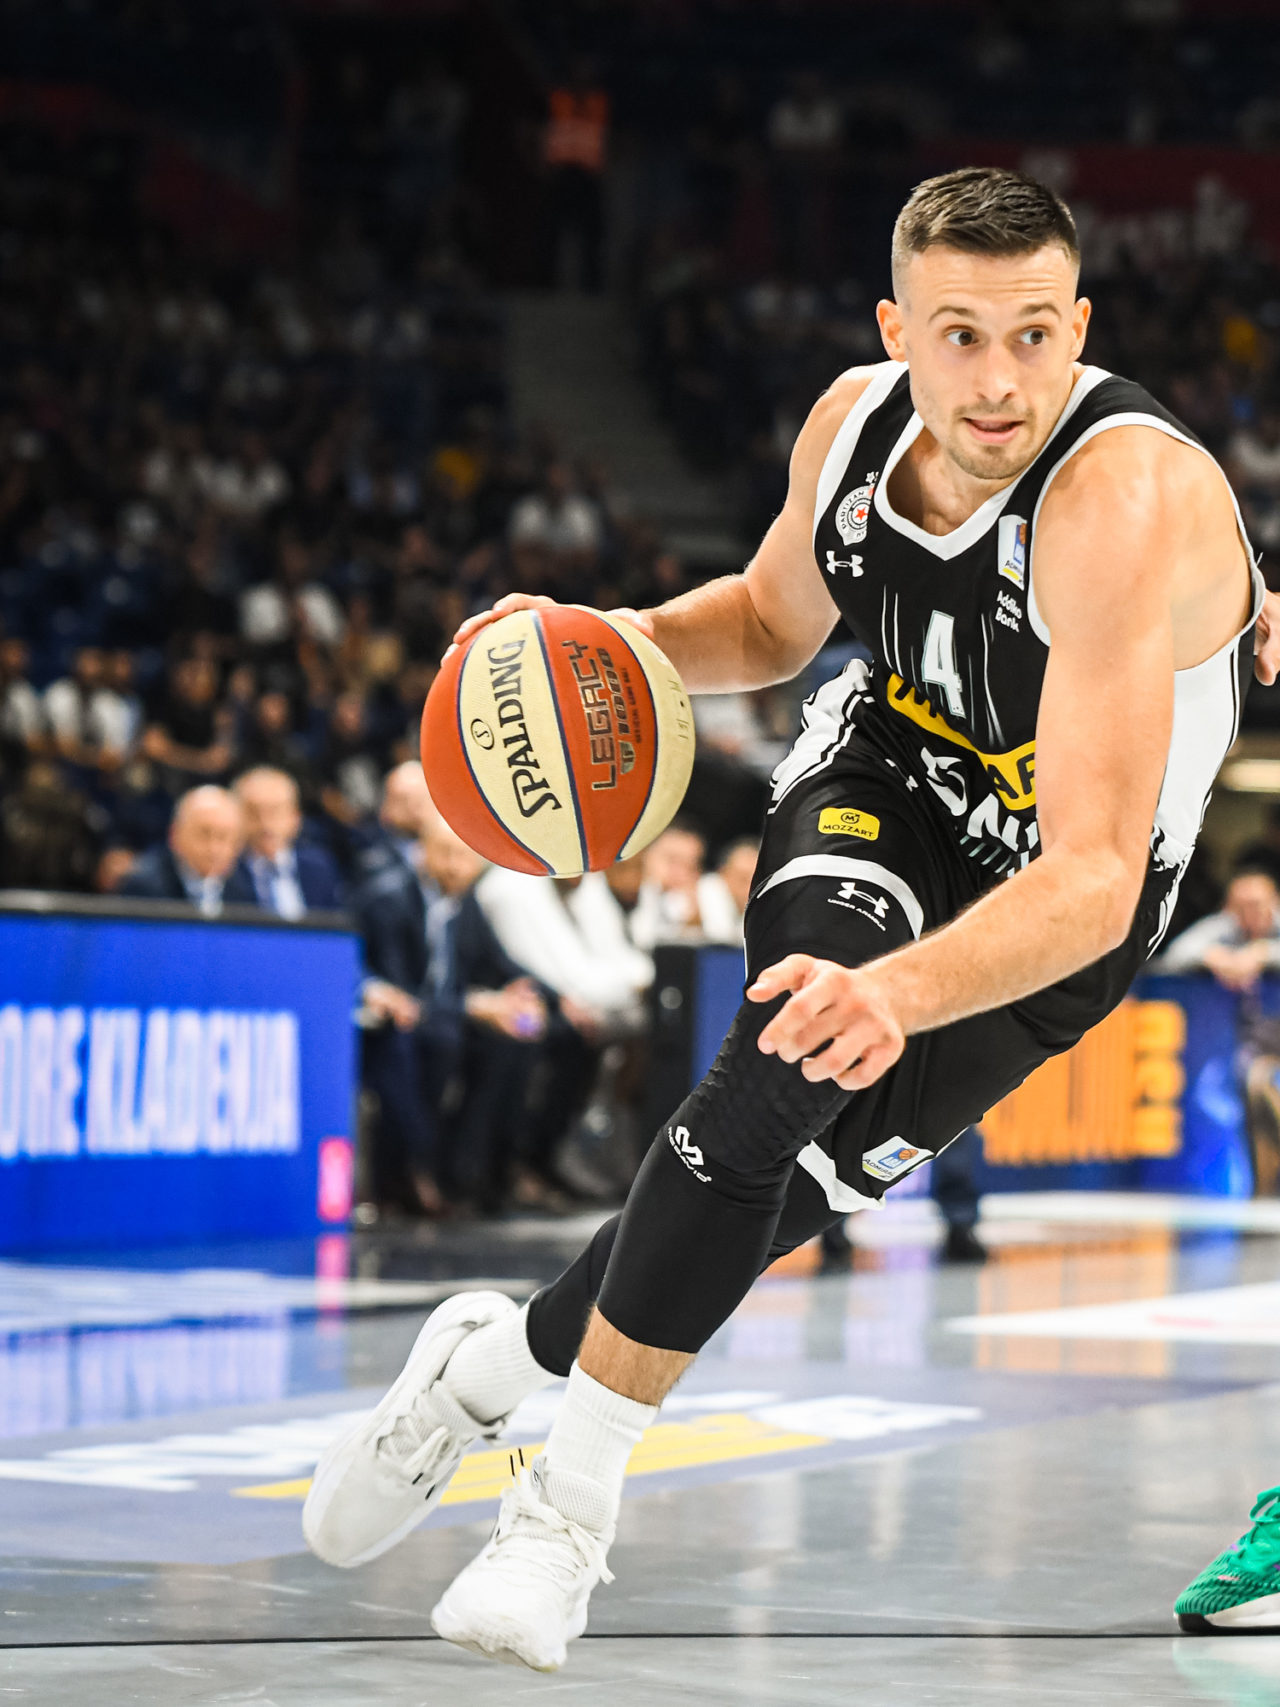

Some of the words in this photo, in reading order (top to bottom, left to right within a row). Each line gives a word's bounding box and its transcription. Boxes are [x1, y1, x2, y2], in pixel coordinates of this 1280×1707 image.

[921, 609, 966, 719] 4
[995, 606, 1020, 632] Bank
[487, 638, 563, 818] SPALDING
[561, 640, 617, 791] LEGACY
[822, 824, 874, 838] MOZZART
